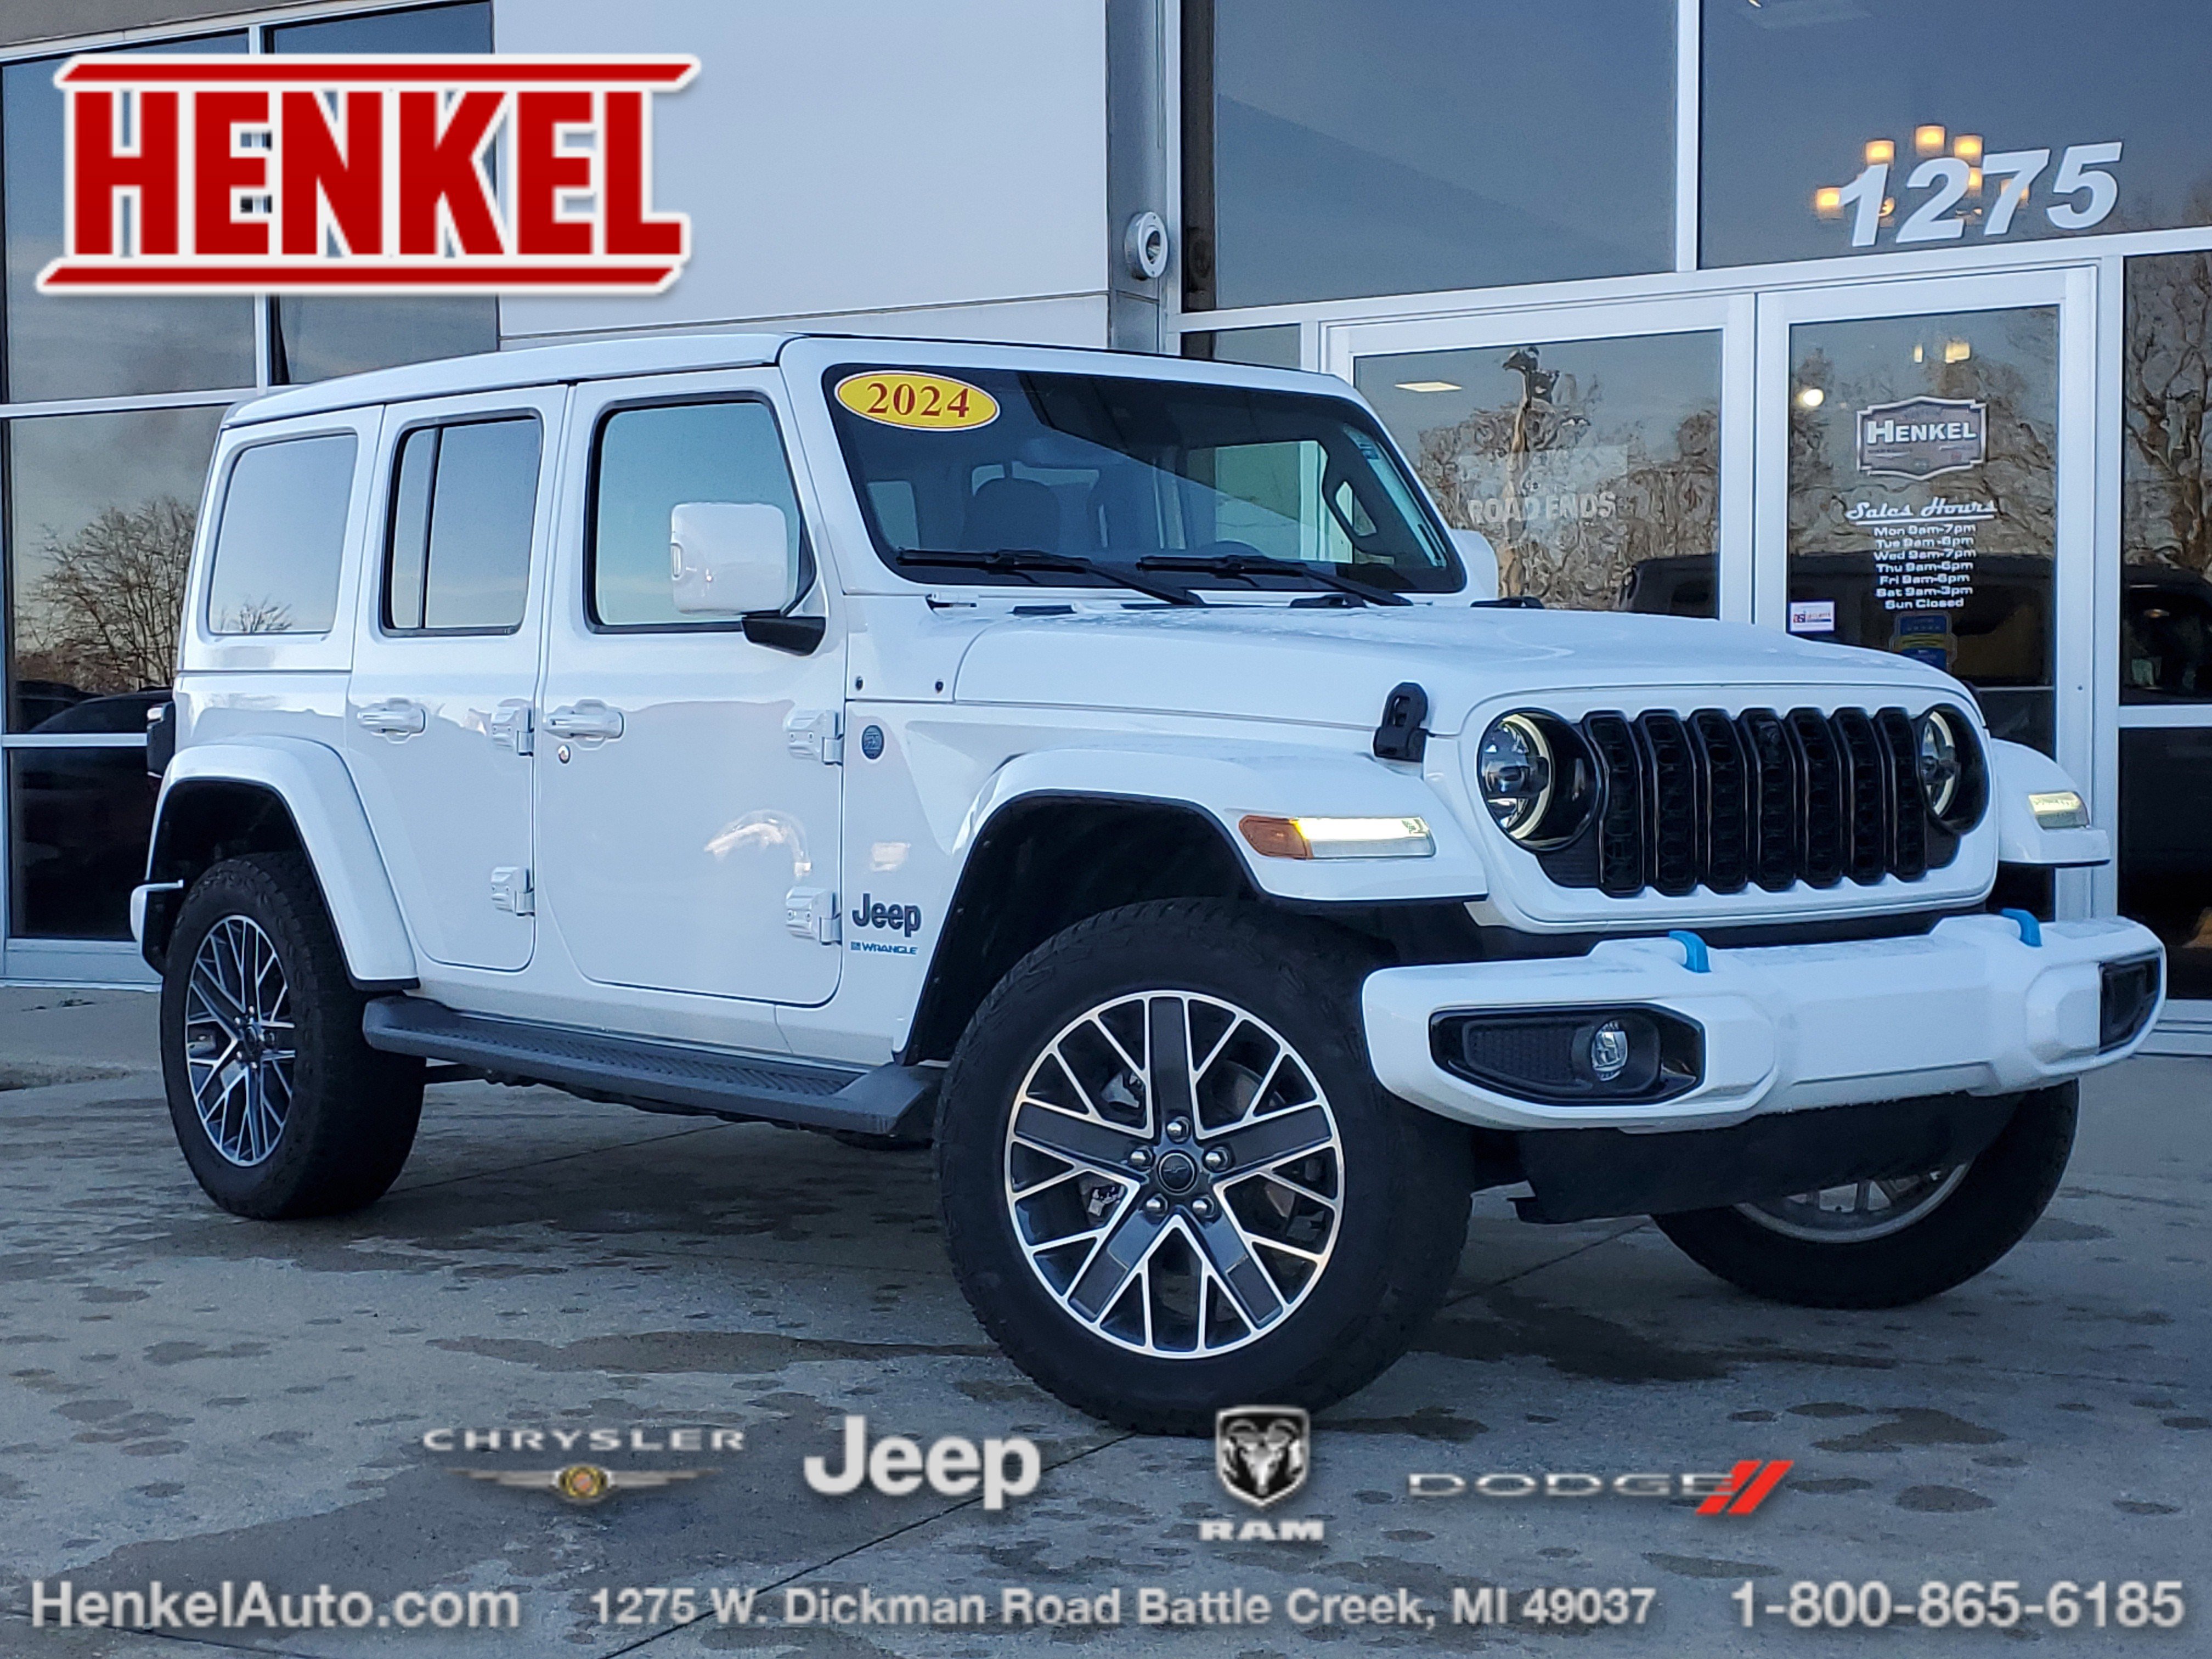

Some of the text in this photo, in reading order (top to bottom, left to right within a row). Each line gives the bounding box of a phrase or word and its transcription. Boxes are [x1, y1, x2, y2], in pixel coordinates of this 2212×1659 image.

[1839, 142, 2122, 246] 1275
[867, 383, 969, 417] 2024
[1845, 496, 1997, 520] Sales Hours
[1874, 527, 1905, 537] Mon
[1875, 539, 1900, 549] Tue
[1874, 550, 1905, 561] Wed
[1876, 563, 1903, 573] Thu
[1880, 575, 1899, 585] Fri
[1876, 588, 1903, 597] Sat
[1885, 597, 1965, 610] Sun Closed
[852, 893, 922, 938] Jeep
